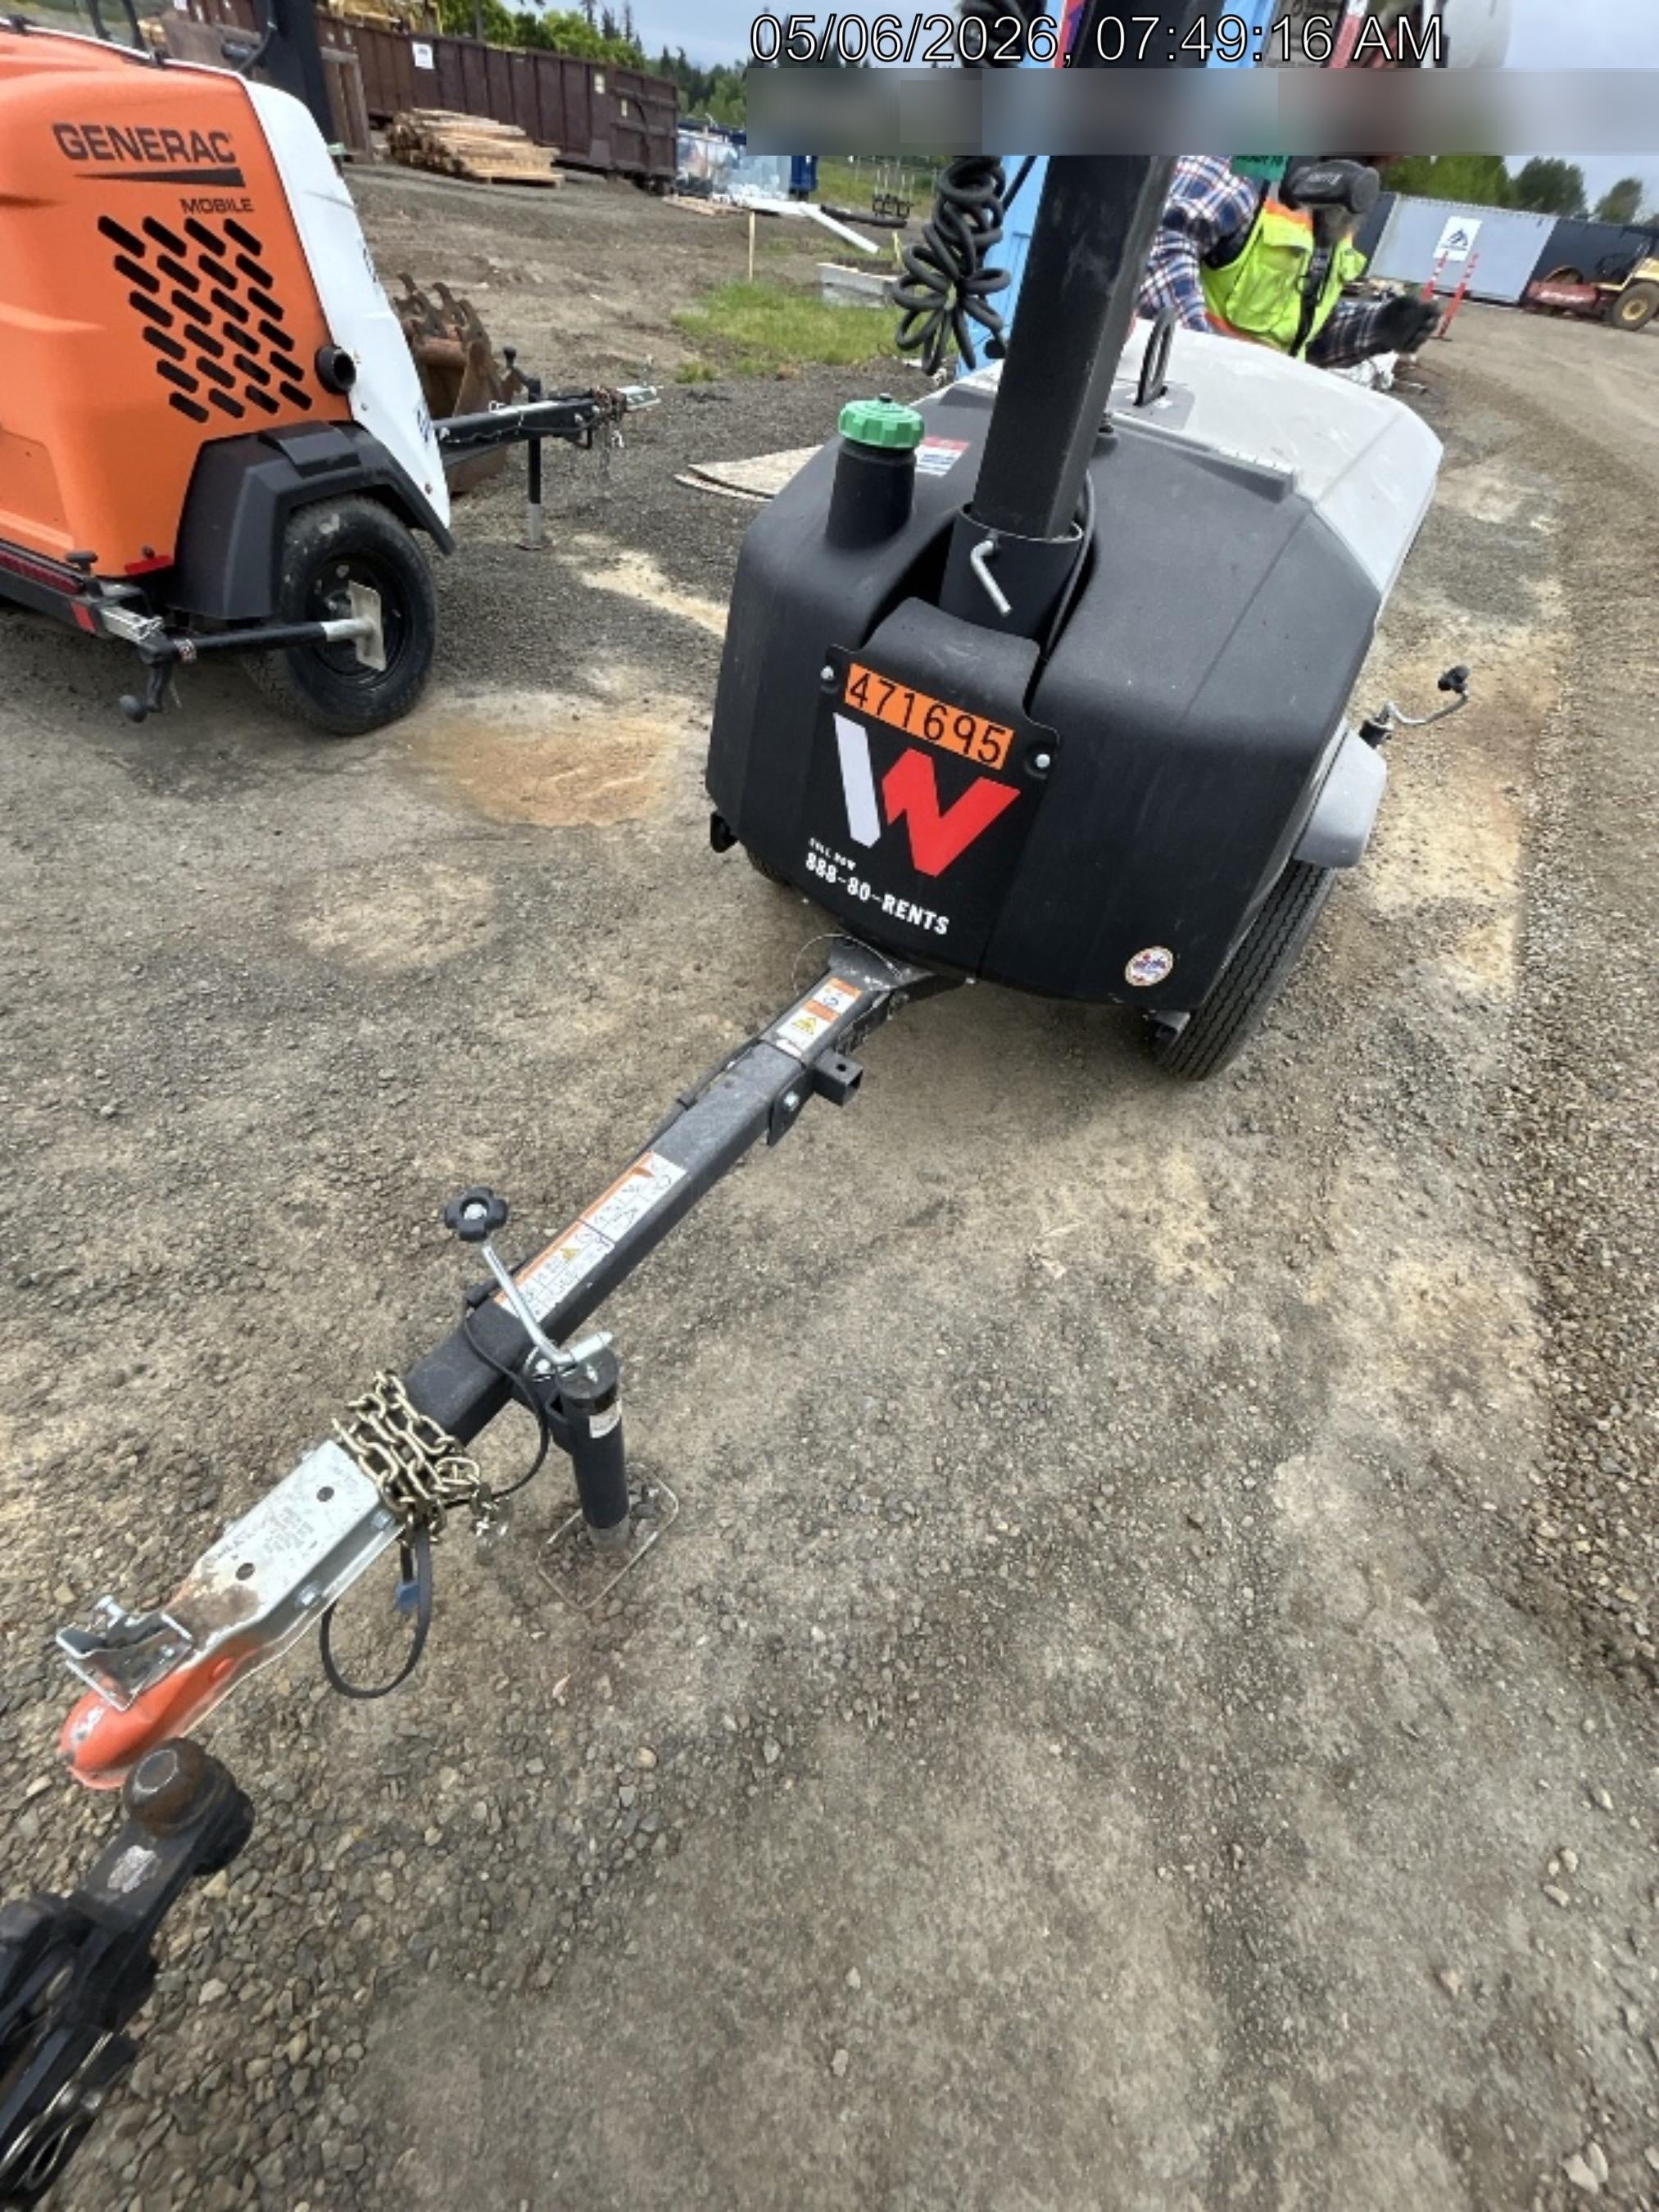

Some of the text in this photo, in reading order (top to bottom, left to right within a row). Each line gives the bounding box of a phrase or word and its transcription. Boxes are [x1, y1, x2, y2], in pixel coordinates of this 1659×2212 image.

[52, 124, 236, 163] GENERAC
[179, 197, 255, 215] MOBILE
[849, 673, 1006, 764] 471695
[805, 851, 950, 936] 888-80-RENTS
